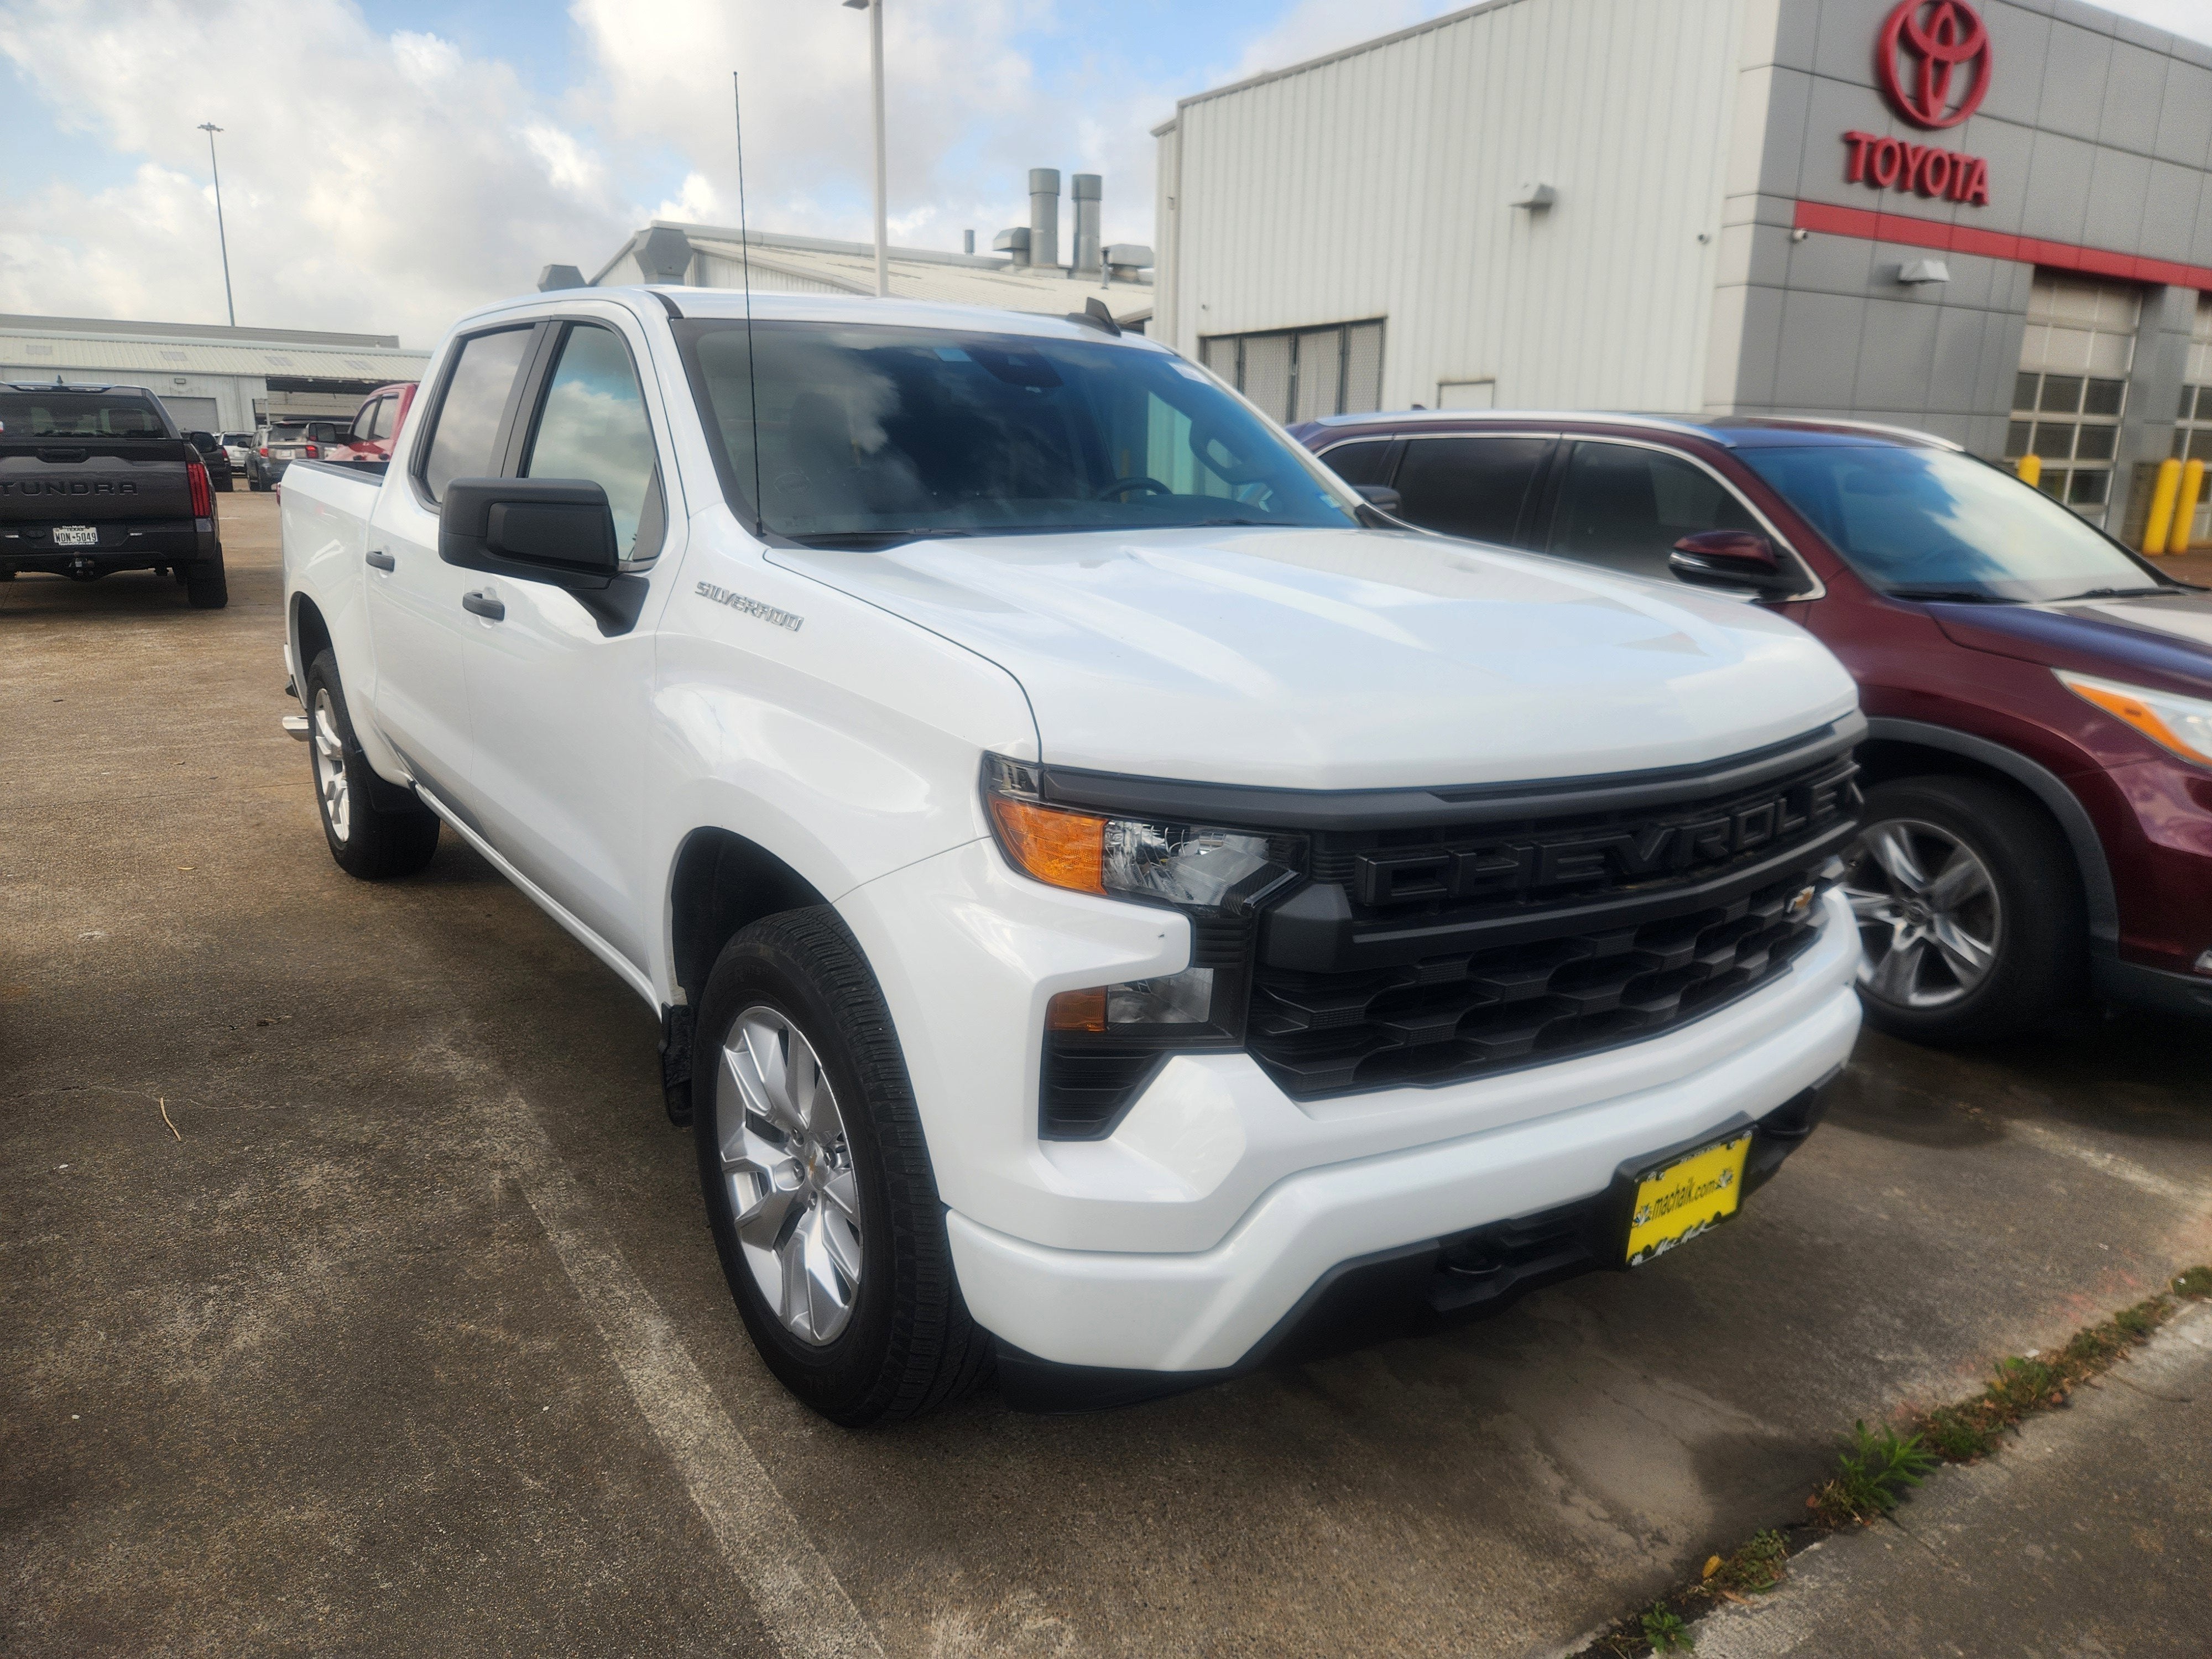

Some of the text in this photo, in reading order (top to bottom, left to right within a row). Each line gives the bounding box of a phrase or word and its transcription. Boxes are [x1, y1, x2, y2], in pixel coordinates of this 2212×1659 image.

[1844, 131, 1989, 206] TOYOTA
[0, 481, 138, 497] TUNDRA
[695, 581, 805, 632] SILVERADO
